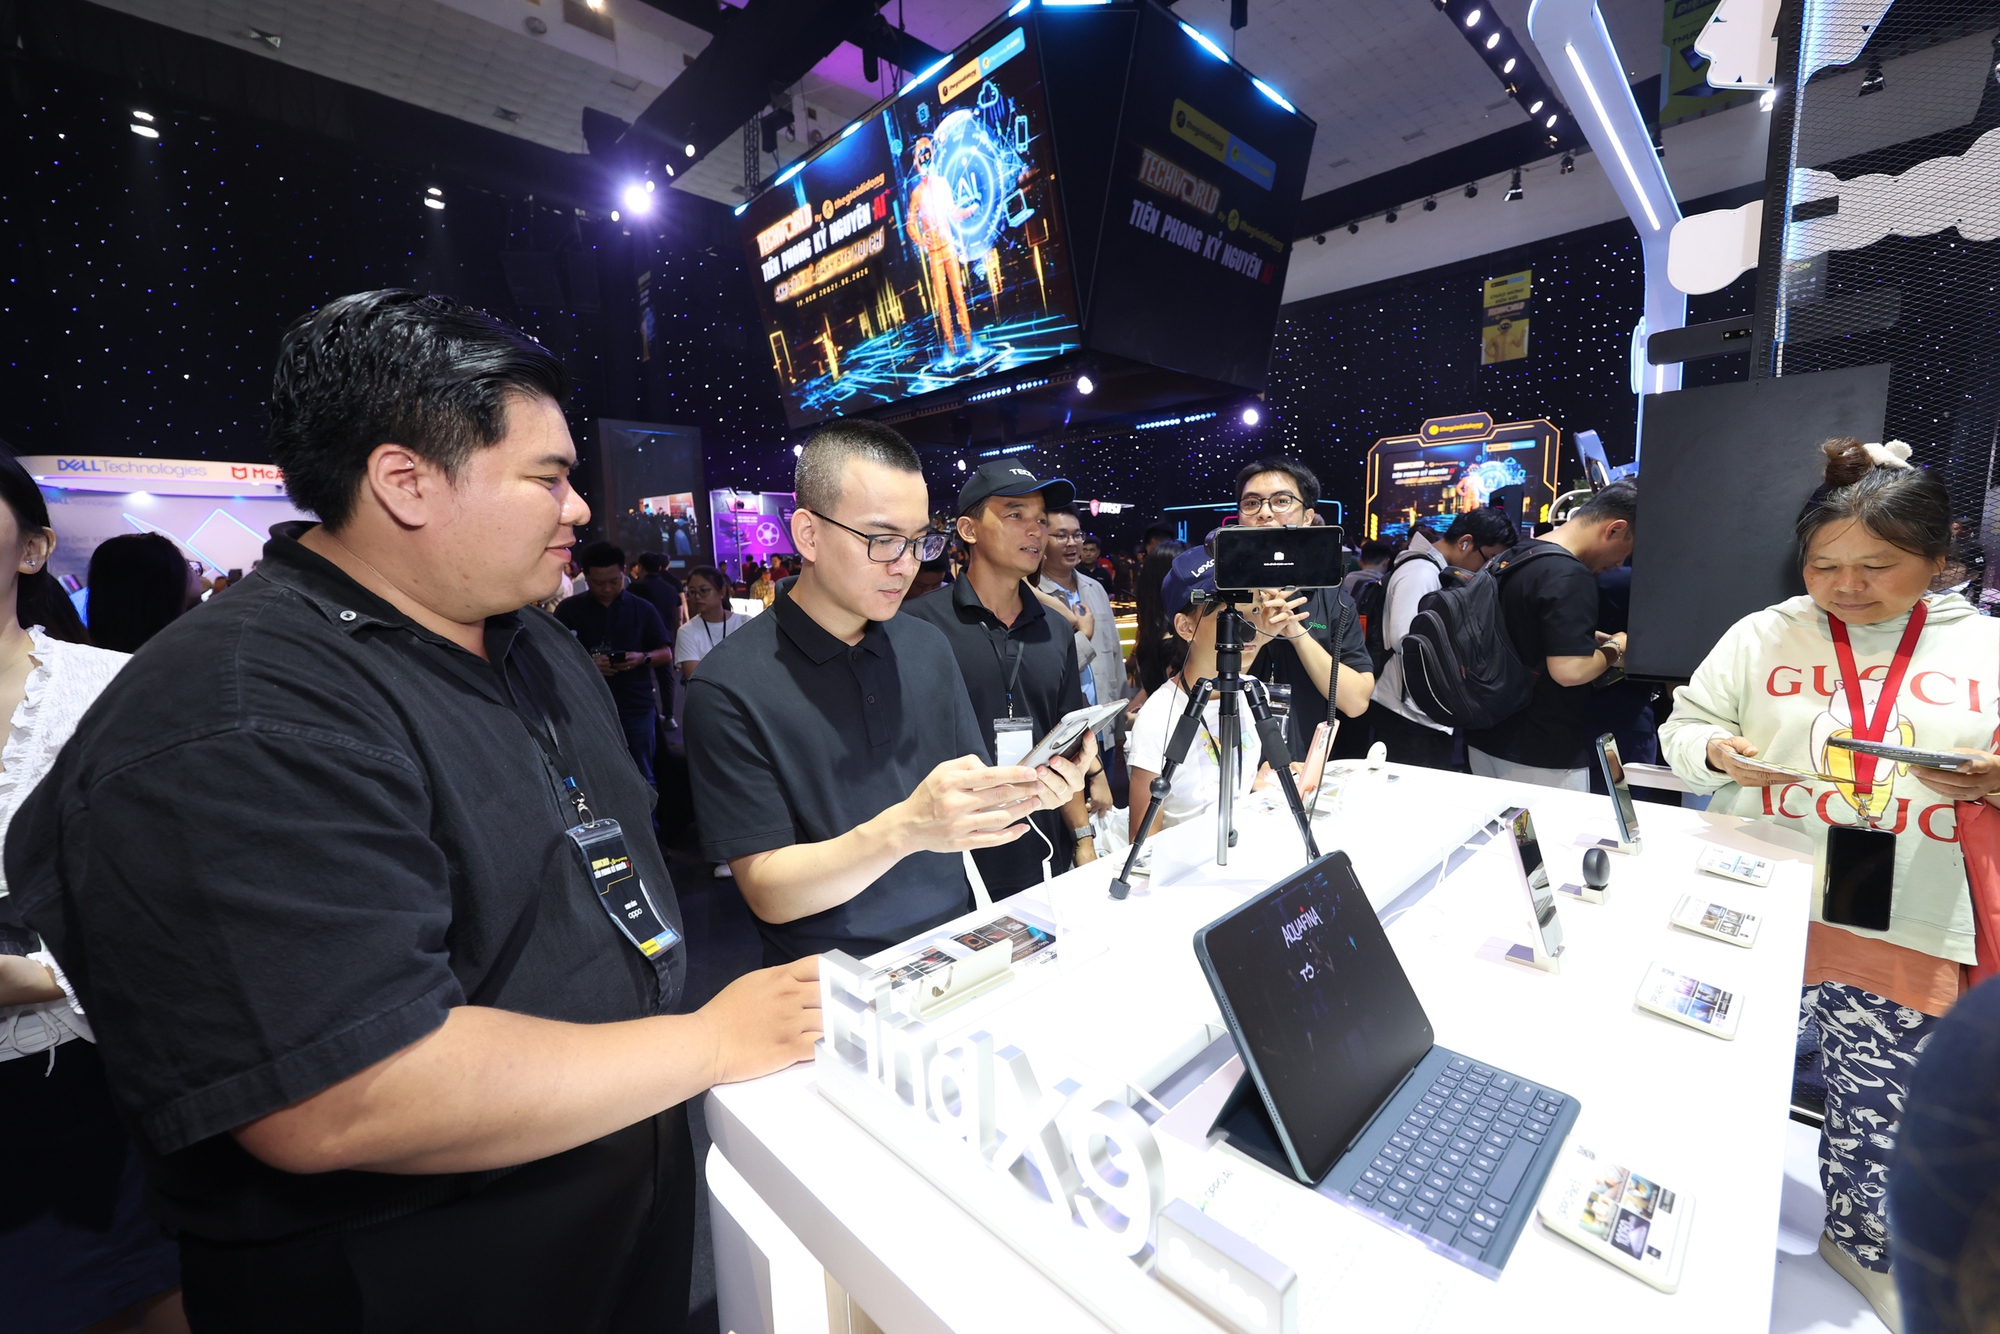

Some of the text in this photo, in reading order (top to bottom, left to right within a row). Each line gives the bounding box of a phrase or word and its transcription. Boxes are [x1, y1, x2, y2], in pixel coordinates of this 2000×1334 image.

[834, 173, 885, 210] thegioididong
[956, 171, 980, 208] AI
[1138, 148, 1220, 214] TECHWORLD
[781, 238, 813, 272] PHONG
[829, 202, 872, 245] NGUYÊN
[873, 193, 887, 221] AI
[1129, 199, 1161, 235] TIÊN
[1160, 214, 1203, 253] PHONG
[1202, 231, 1223, 261] KỶ
[1220, 243, 1263, 280] NGUYÊN
[57, 459, 208, 478] DELL Technologies
[252, 467, 285, 480] McA
[1098, 502, 1122, 514] msi
[1281, 906, 1324, 949] AQUAFINA
[1204, 1177, 1227, 1199] OPPO
